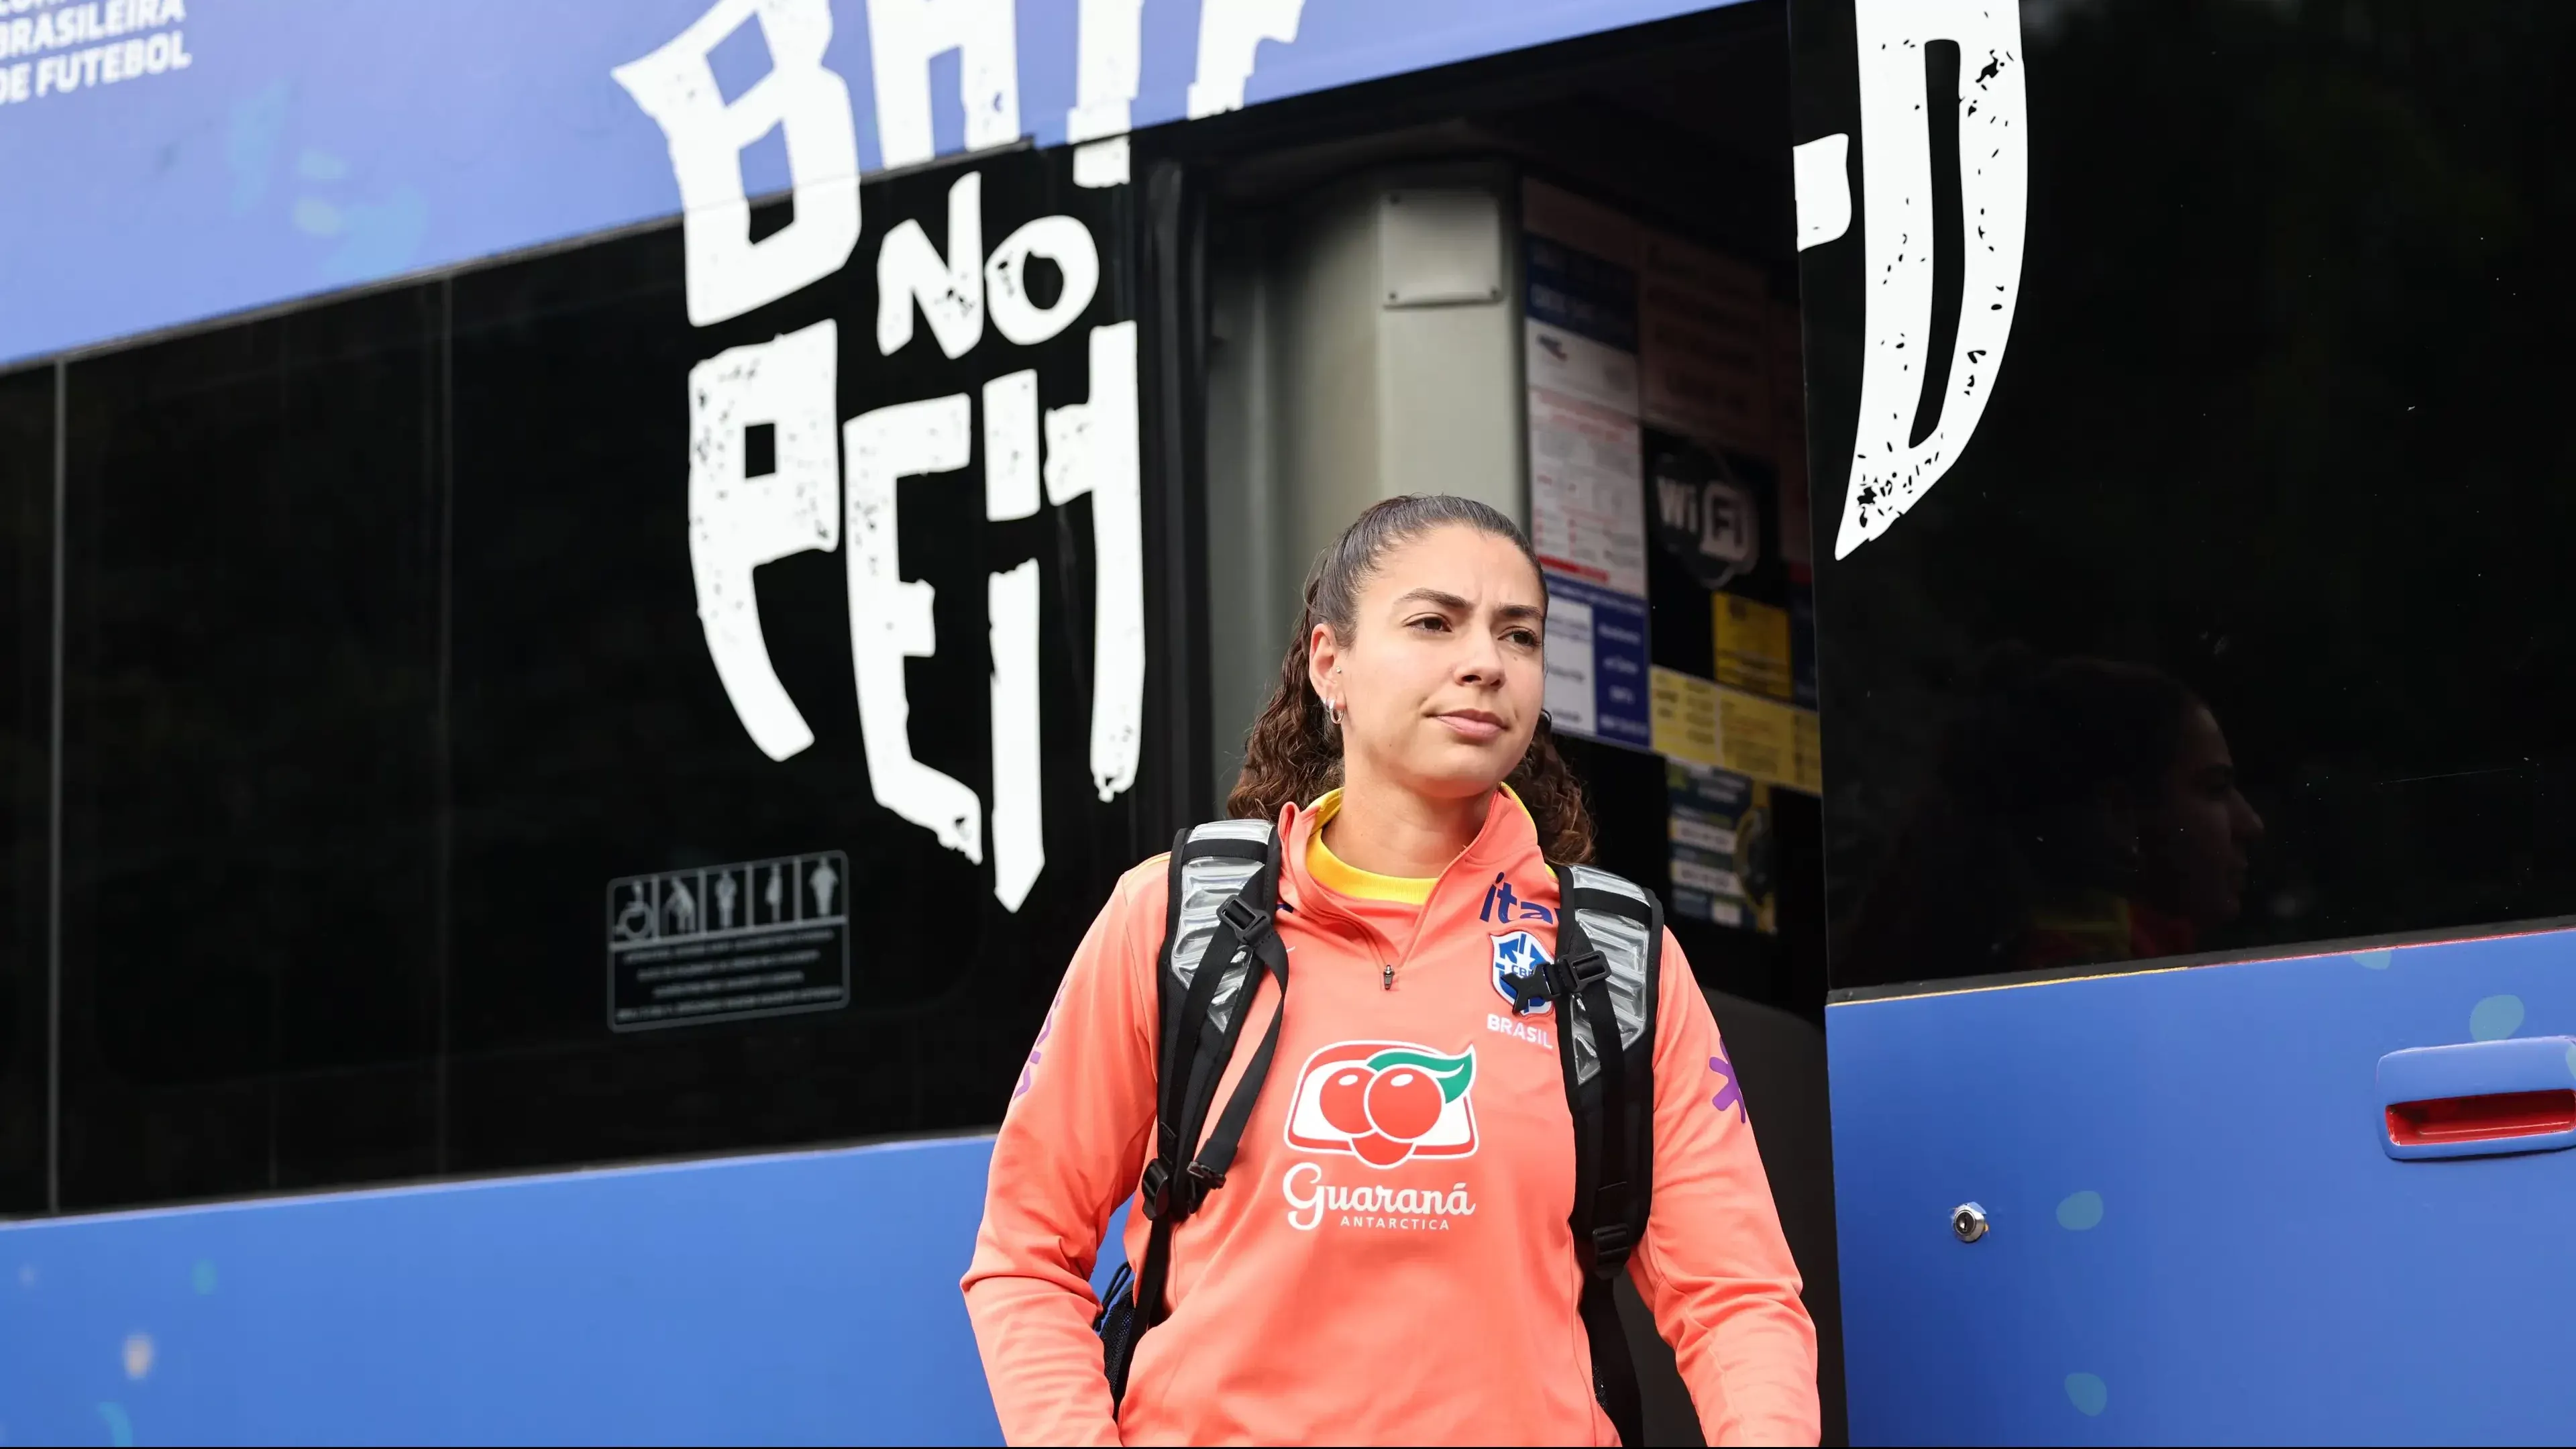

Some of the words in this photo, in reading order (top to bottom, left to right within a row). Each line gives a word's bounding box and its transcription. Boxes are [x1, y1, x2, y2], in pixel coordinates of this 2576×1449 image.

[36, 30, 193, 97] FUTEBOL
[877, 172, 1098, 359] NO
[1479, 871, 1562, 925] ita
[1487, 1013, 1554, 1049] BRASIL
[1282, 1161, 1476, 1230] Guaraná
[1340, 1215, 1449, 1230] ANTARCTICA
